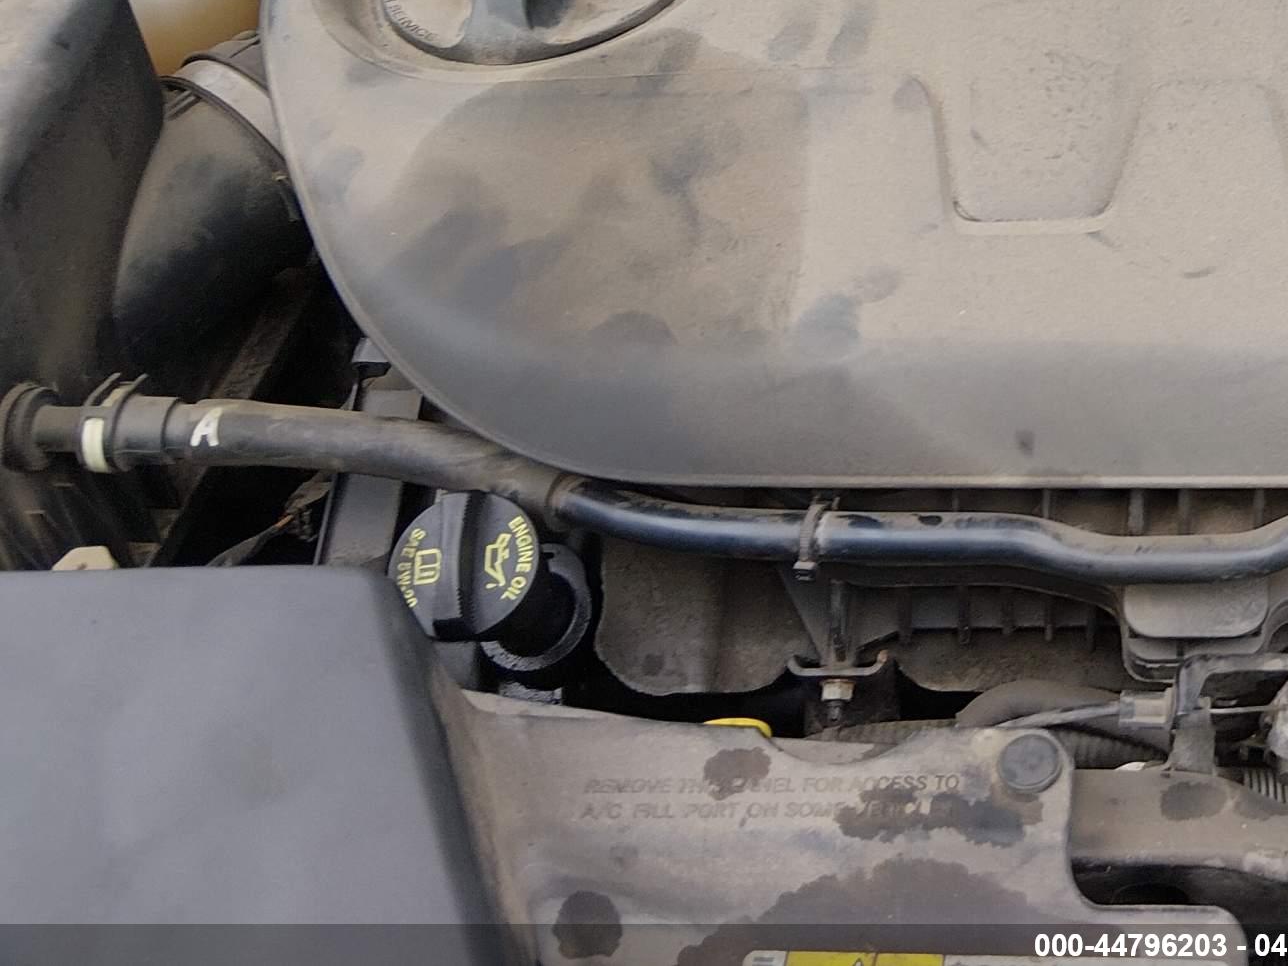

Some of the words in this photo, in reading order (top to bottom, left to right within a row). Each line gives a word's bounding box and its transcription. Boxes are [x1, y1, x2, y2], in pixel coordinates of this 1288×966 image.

[389, 4, 438, 42] SERVICE
[190, 407, 223, 447] A
[401, 528, 427, 559] SAE
[508, 515, 534, 574] ENGINE
[500, 576, 527, 601] OIL
[583, 778, 673, 794] REMOVE
[802, 777, 844, 793] FOR
[849, 775, 928, 792] ACCESS
[934, 775, 960, 791] TO
[684, 802, 741, 819] PORT
[747, 802, 780, 819] ON
